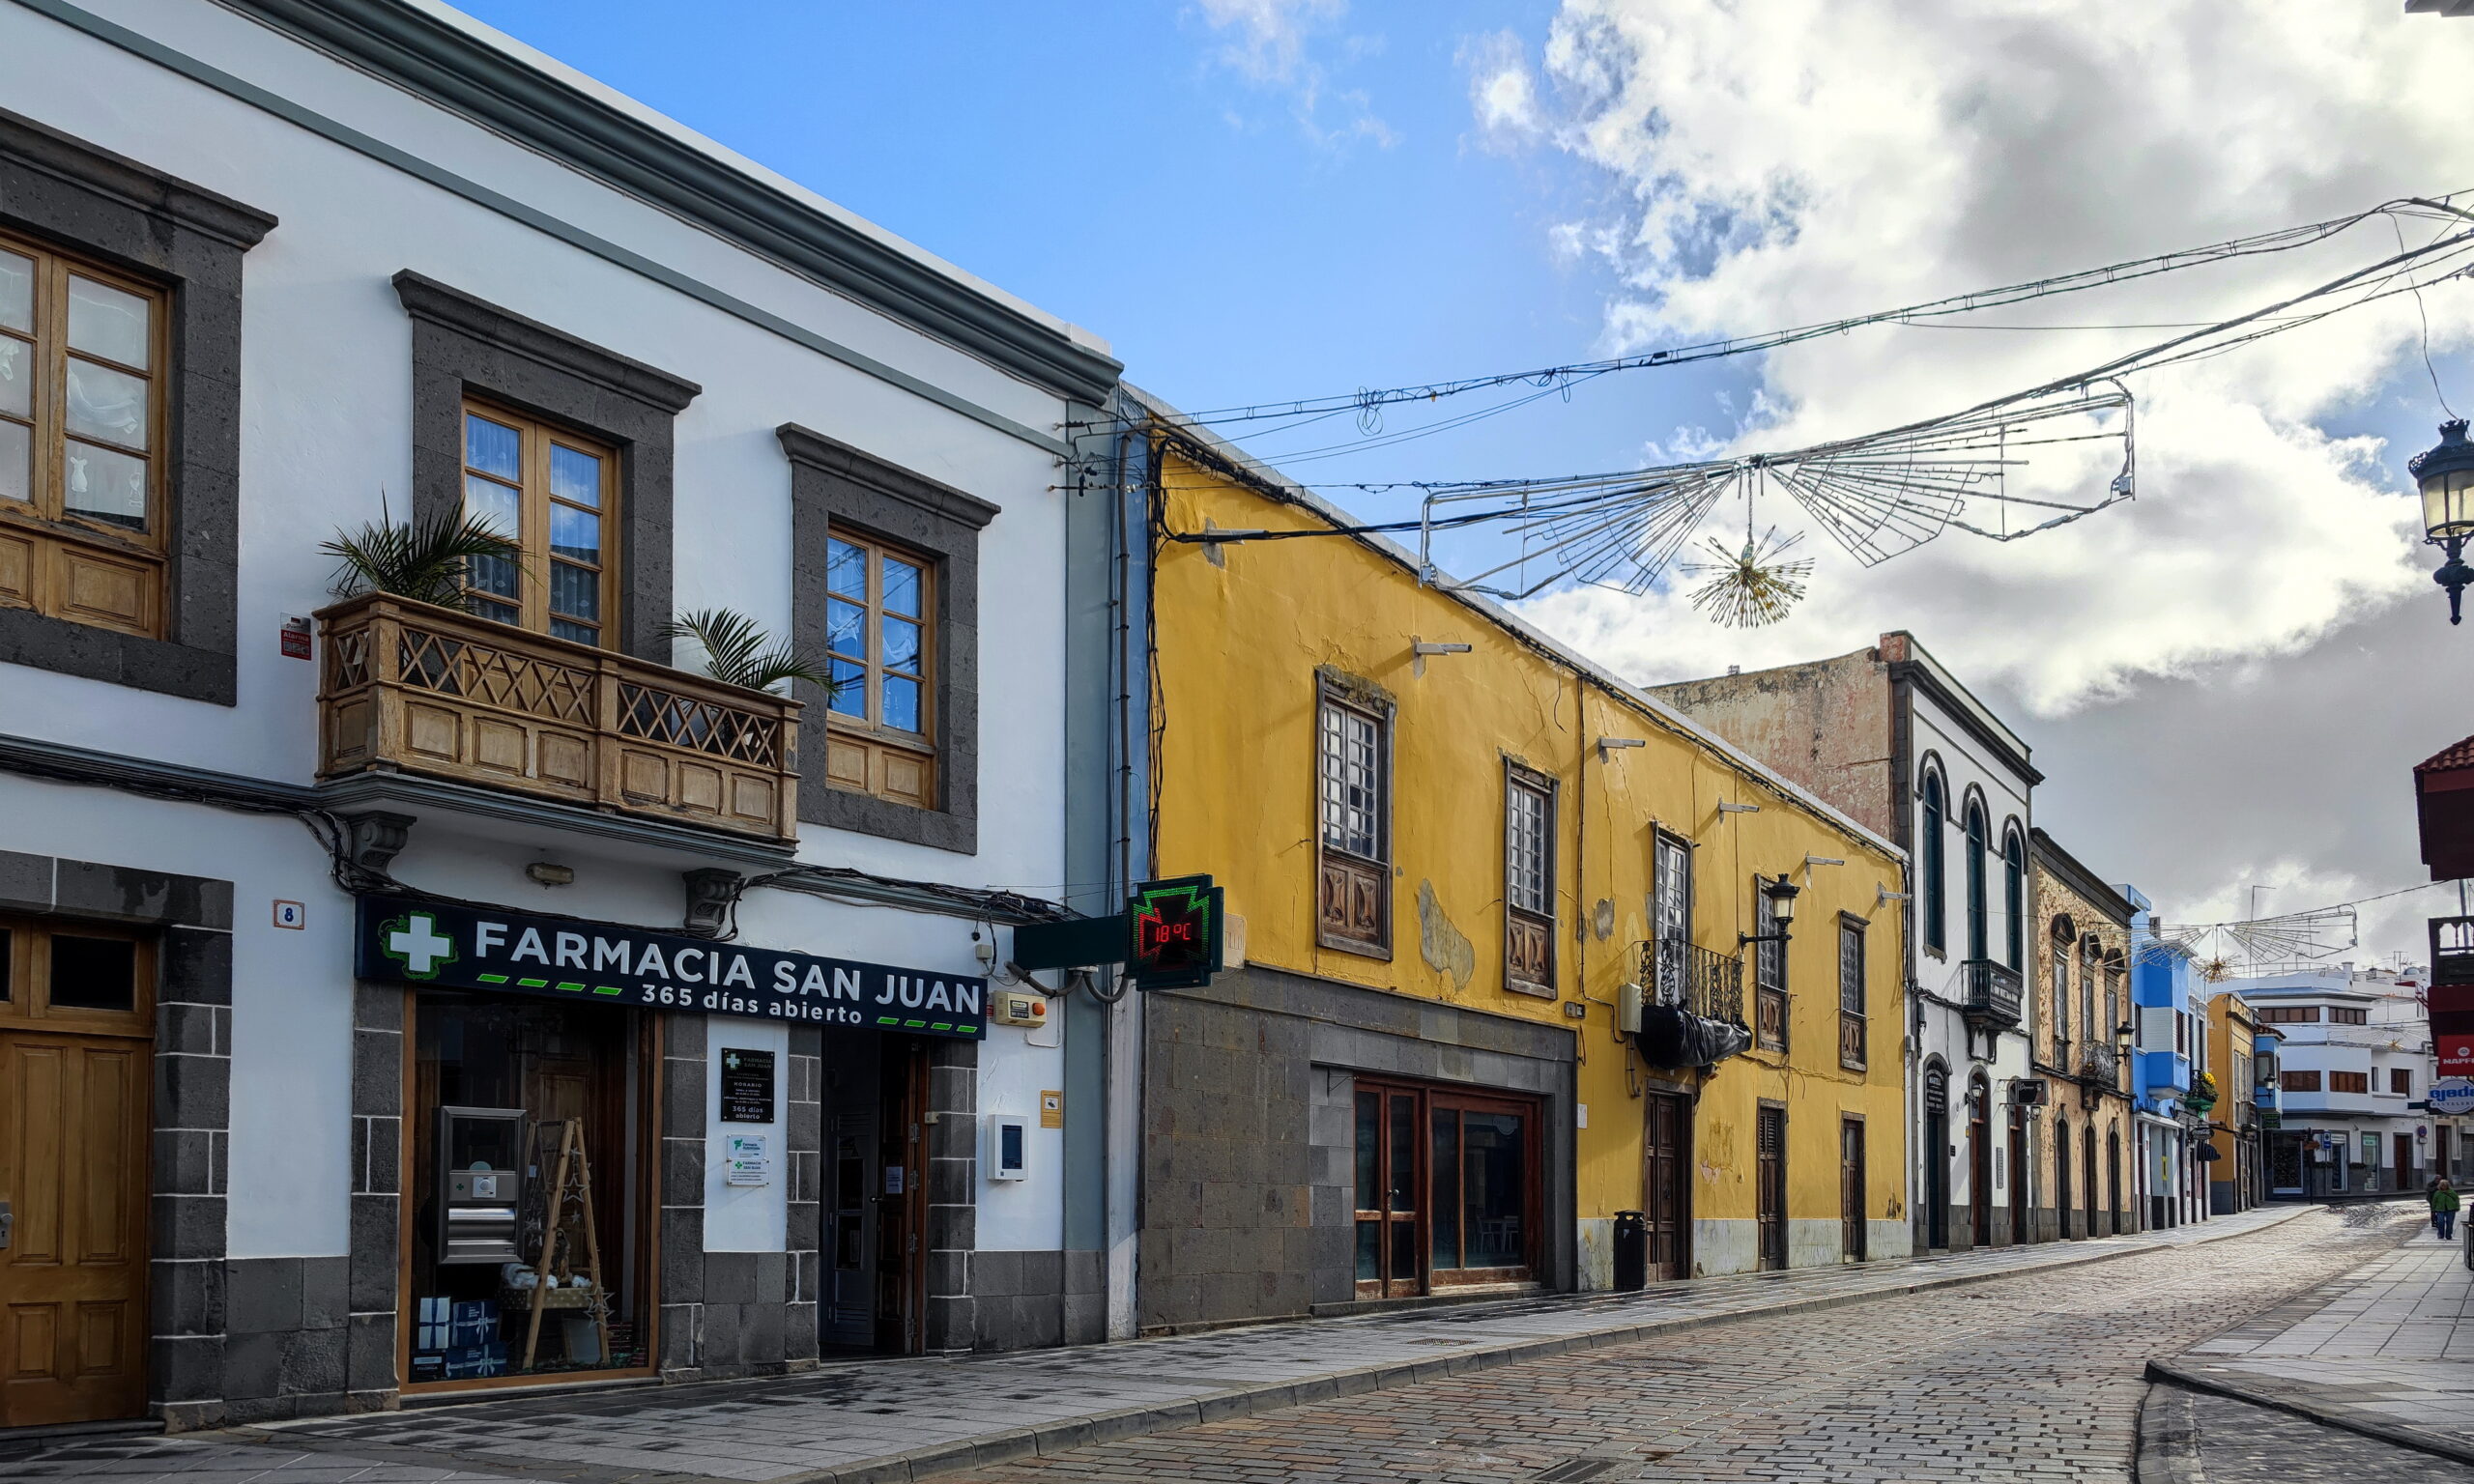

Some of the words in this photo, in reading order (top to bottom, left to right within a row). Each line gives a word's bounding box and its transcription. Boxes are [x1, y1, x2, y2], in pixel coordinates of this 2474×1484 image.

[284, 907, 294, 923] 8
[1156, 925, 1169, 943] 18
[475, 921, 756, 989] FARMACIA
[773, 960, 861, 1002] SAN
[875, 974, 980, 1015] JUAN
[642, 984, 693, 1007] 365
[703, 991, 759, 1013] días
[768, 999, 862, 1024] abierto
